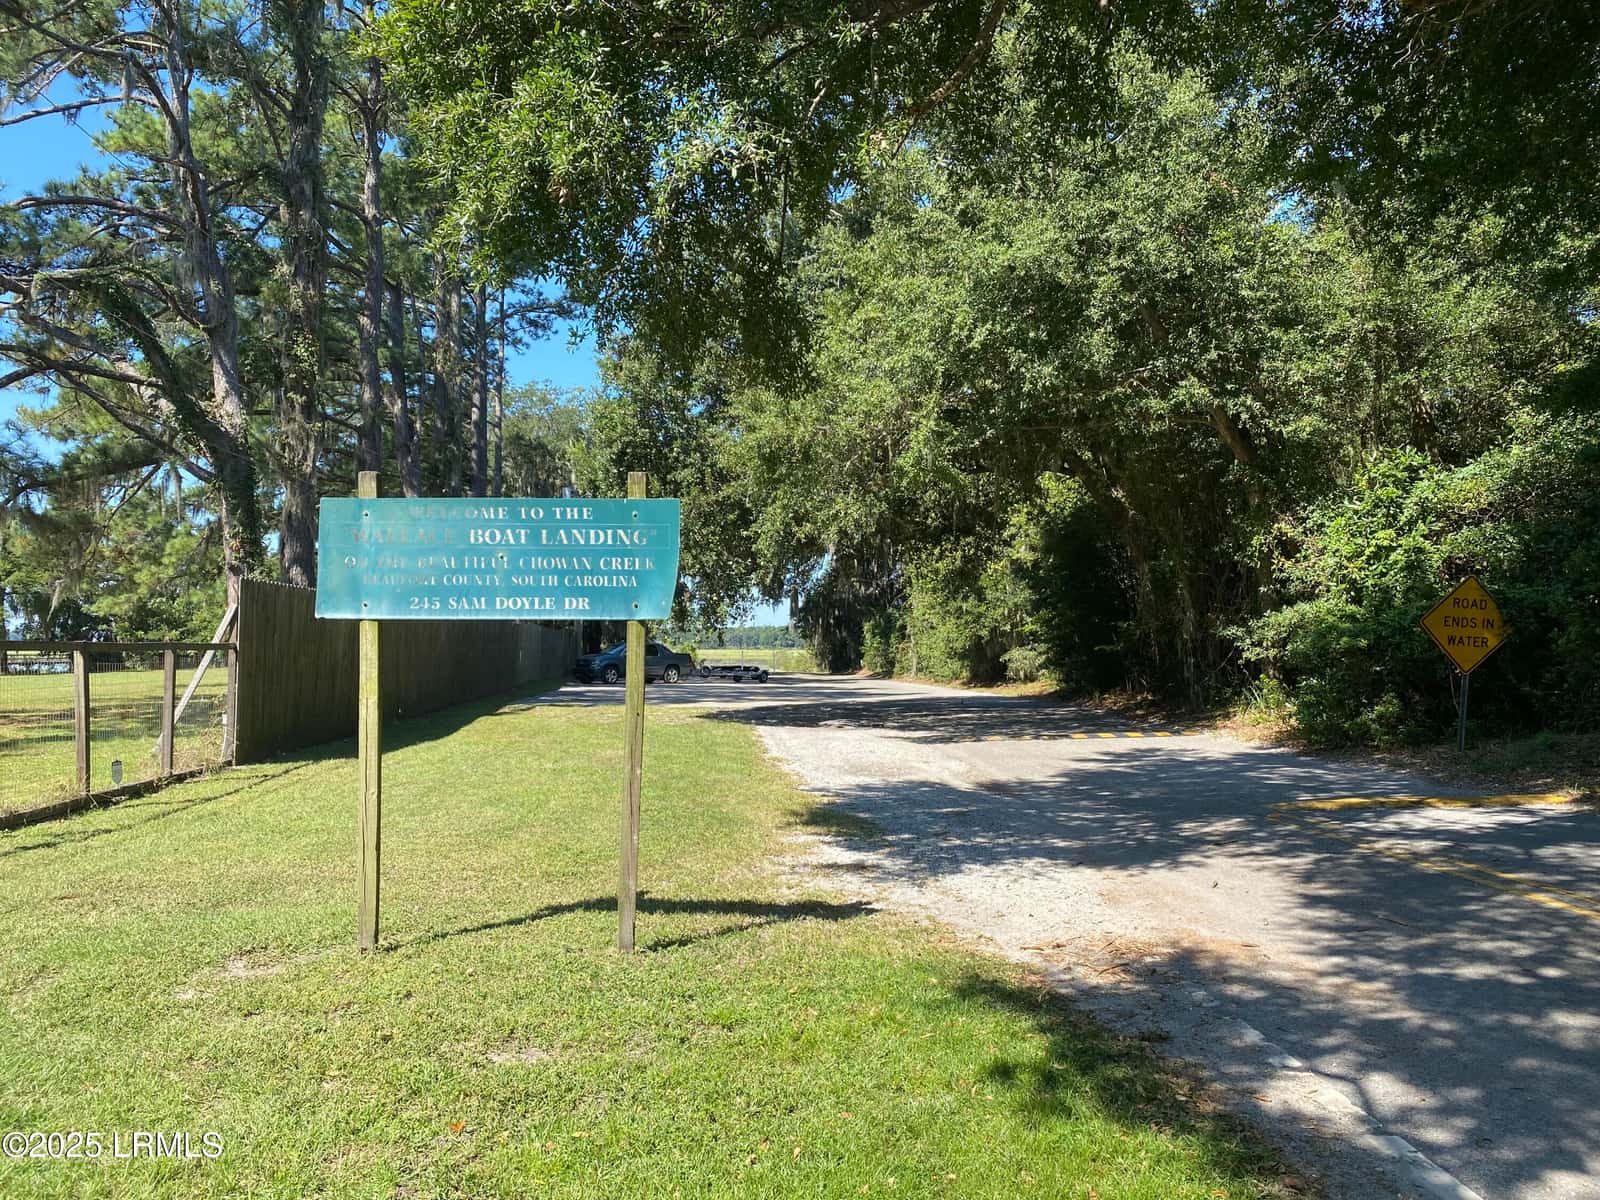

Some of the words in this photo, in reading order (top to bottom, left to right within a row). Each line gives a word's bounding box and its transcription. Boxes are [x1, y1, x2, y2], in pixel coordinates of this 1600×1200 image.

[407, 506, 509, 520] WOME
[519, 506, 544, 520] TO
[552, 506, 593, 520] THE
[469, 527, 530, 545] BOAT
[519, 556, 592, 570] CHOWAN
[511, 575, 559, 587] SOUTH
[564, 575, 638, 588] CAROLINA
[409, 596, 441, 610] 245
[448, 596, 488, 610] SAM
[495, 596, 556, 610] DOYLE
[563, 596, 591, 610] DR
[1452, 597, 1488, 610] ROAD
[1443, 615, 1477, 629] ENDS
[1482, 617, 1495, 630] IN
[1447, 635, 1489, 648] WATER
